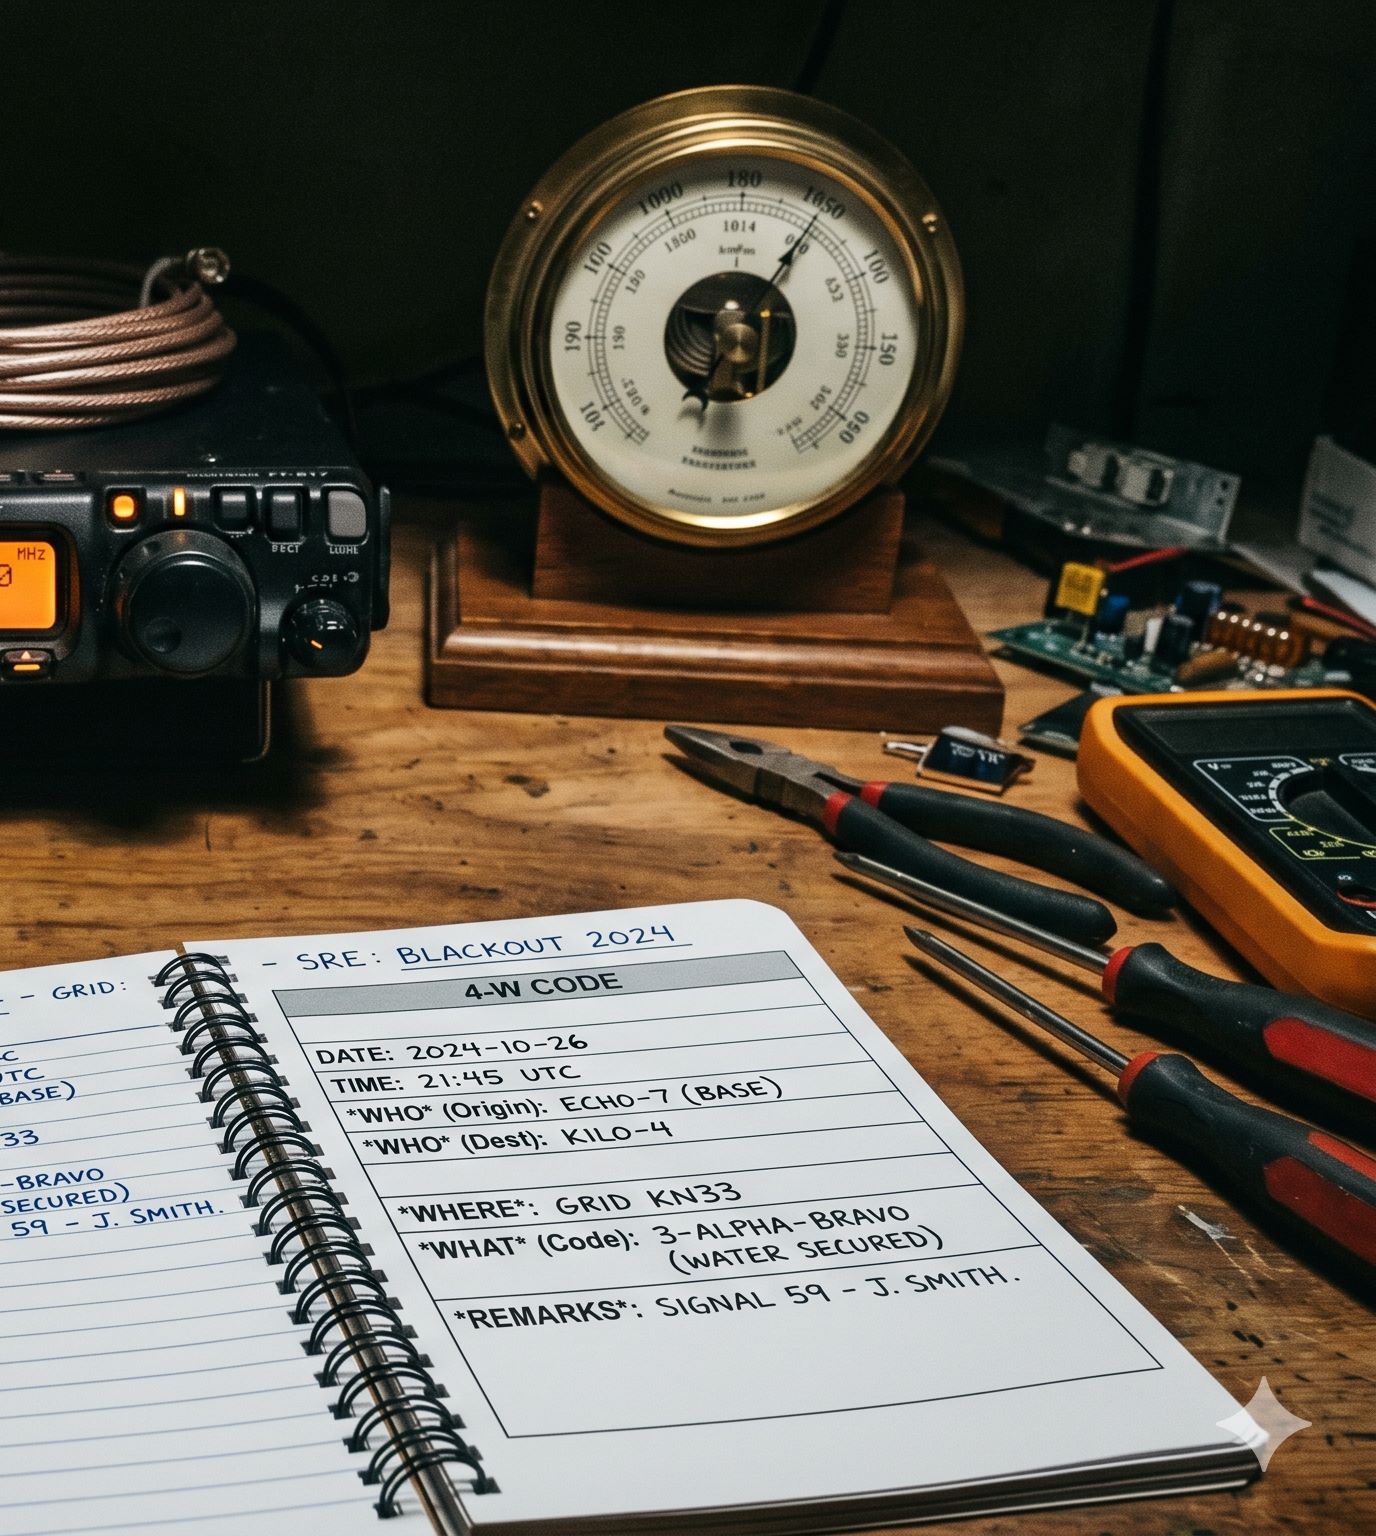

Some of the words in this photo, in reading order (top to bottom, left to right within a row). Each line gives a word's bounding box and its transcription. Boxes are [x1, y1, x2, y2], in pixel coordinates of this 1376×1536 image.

[638, 183, 684, 215] 1000
[723, 220, 756, 232] 1014
[17, 547, 46, 561] MHz
[296, 950, 382, 971] SRE:
[396, 935, 564, 966] BLACKOUT
[586, 925, 676, 948] 2024
[52, 981, 127, 1000] GRID:
[464, 980, 521, 1001] 4-W
[530, 972, 624, 996] CODE
[315, 1047, 394, 1066] DATE:
[405, 1033, 590, 1062] 2024-10-26
[330, 1076, 404, 1096] TIME:
[417, 1068, 504, 1091] 21:45
[519, 1064, 582, 1082] UTC
[442, 1097, 549, 1123] (Origin):
[559, 1087, 671, 1114] ECHO-7
[681, 1075, 784, 1106] (BASE)
[460, 1130, 549, 1155] (Dest):
[560, 1120, 674, 1147] KILO-4
[0, 1182, 130, 1212] SECURED)
[555, 1194, 631, 1215] GRID
[646, 1181, 742, 1209] KN33
[12, 1219, 49, 1237] 59
[92, 1212, 119, 1229] J.
[130, 1200, 224, 1225] SMITH.
[537, 1228, 640, 1257] (Code):
[652, 1205, 910, 1246] 3-ALPHA-BRAVO
[669, 1243, 789, 1276] (WATER
[796, 1224, 944, 1259] SECURED)
[655, 1290, 776, 1317] SIGNAL
[784, 1284, 831, 1303] 59
[865, 1277, 899, 1297] J.
[905, 1265, 1021, 1293] SMITH.
